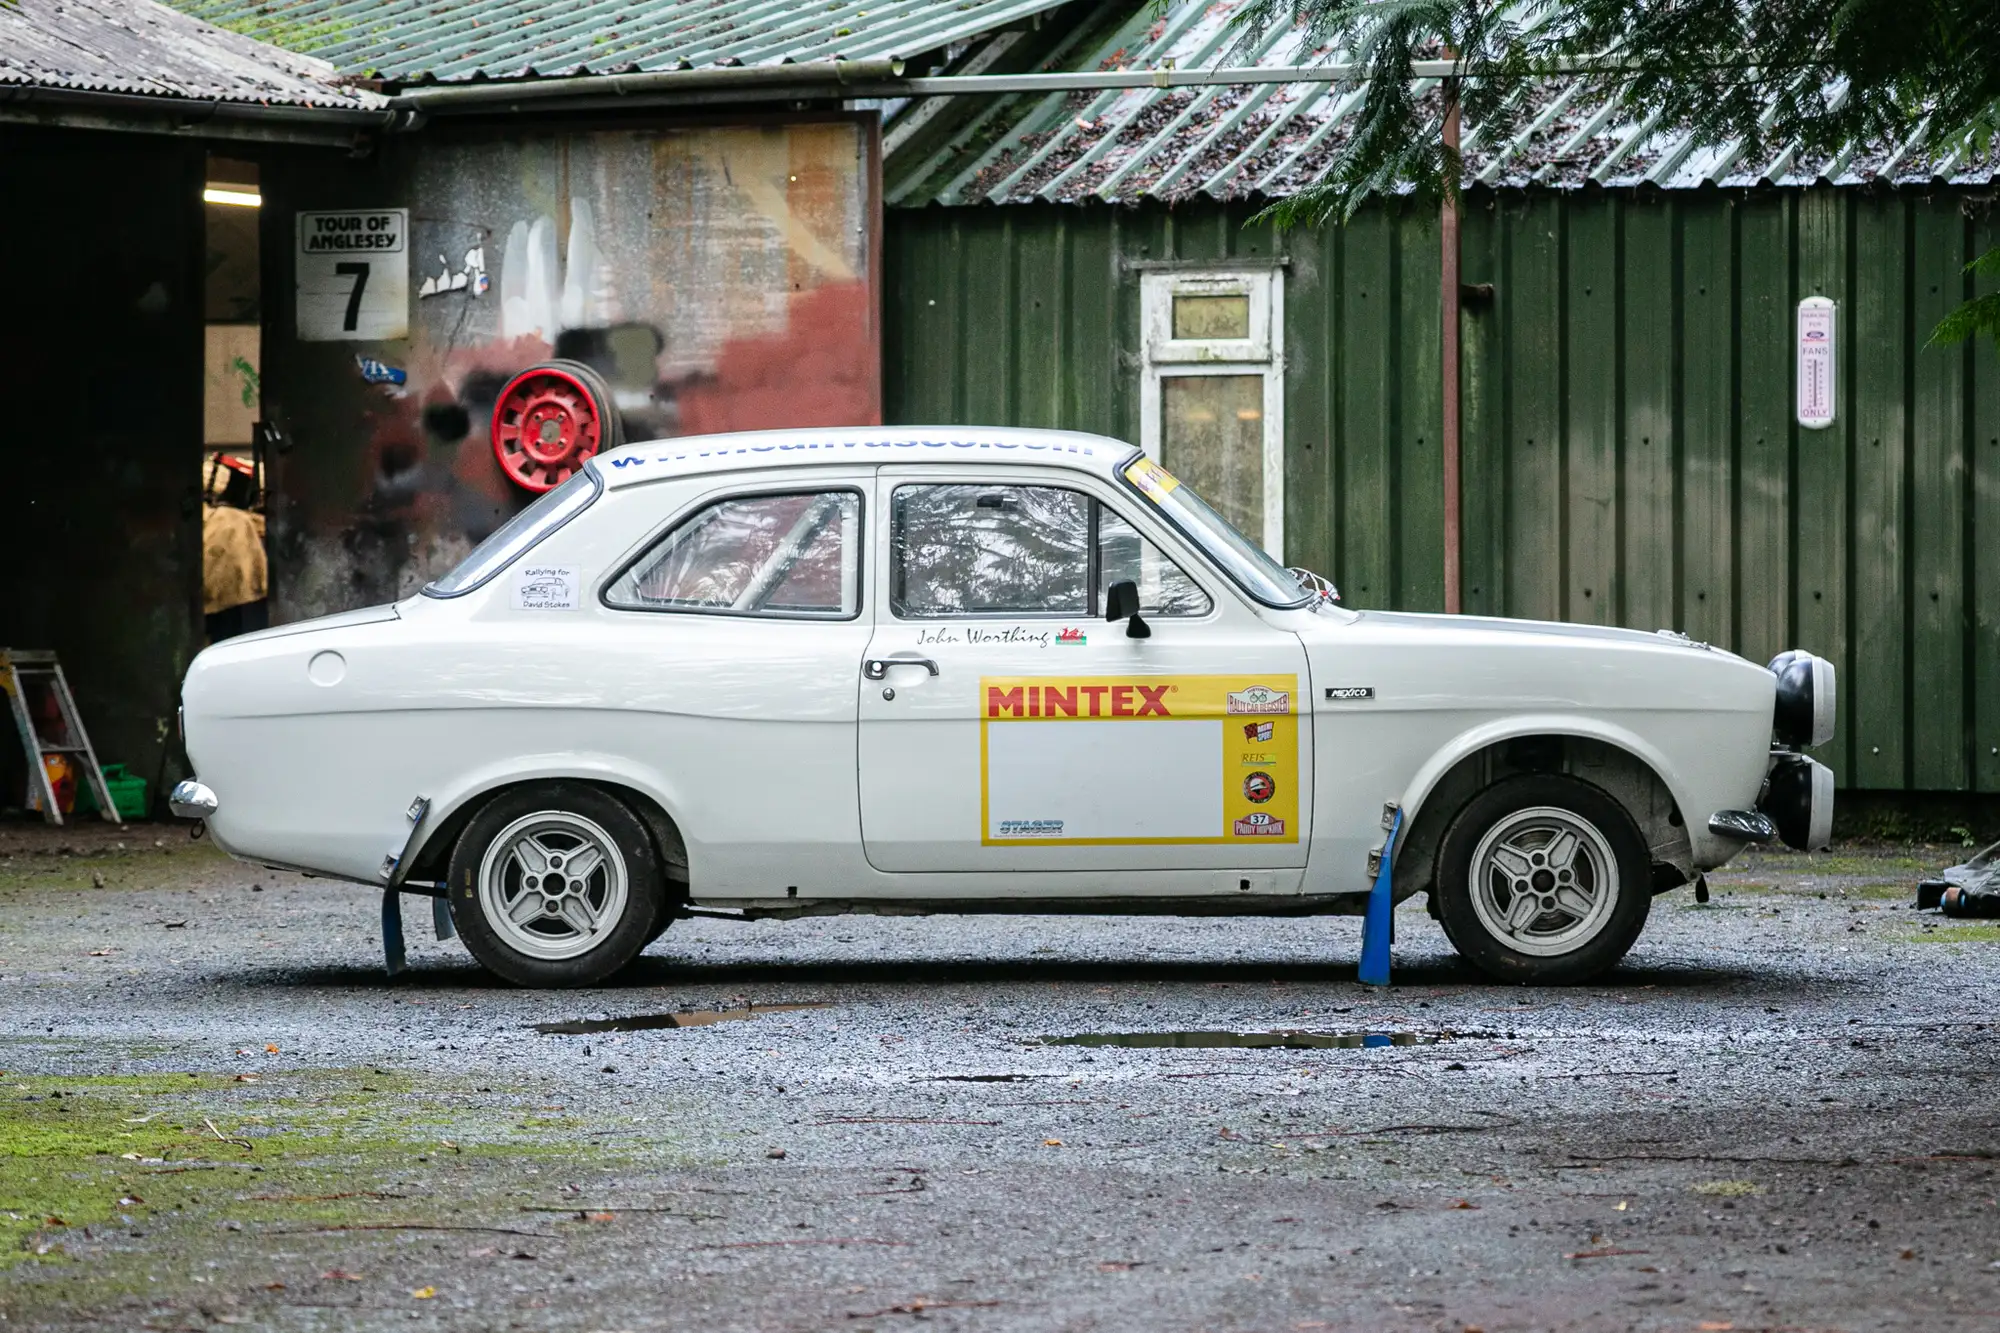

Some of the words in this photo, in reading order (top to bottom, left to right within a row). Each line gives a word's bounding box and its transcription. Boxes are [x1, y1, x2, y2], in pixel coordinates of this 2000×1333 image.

[315, 217, 362, 232] TOUR
[367, 216, 391, 231] OF
[309, 233, 396, 250] ANGLESEY
[335, 262, 370, 332] 7
[1802, 347, 1828, 355] FANS
[1802, 408, 1828, 418] ONLY
[525, 568, 556, 577] Rallying
[557, 568, 570, 576] for
[523, 600, 543, 608] David
[917, 627, 959, 646] John
[967, 626, 1051, 648] Worthing
[1331, 687, 1367, 697] MEXICO
[1242, 753, 1265, 762] REIS
[1252, 814, 1266, 824] 37
